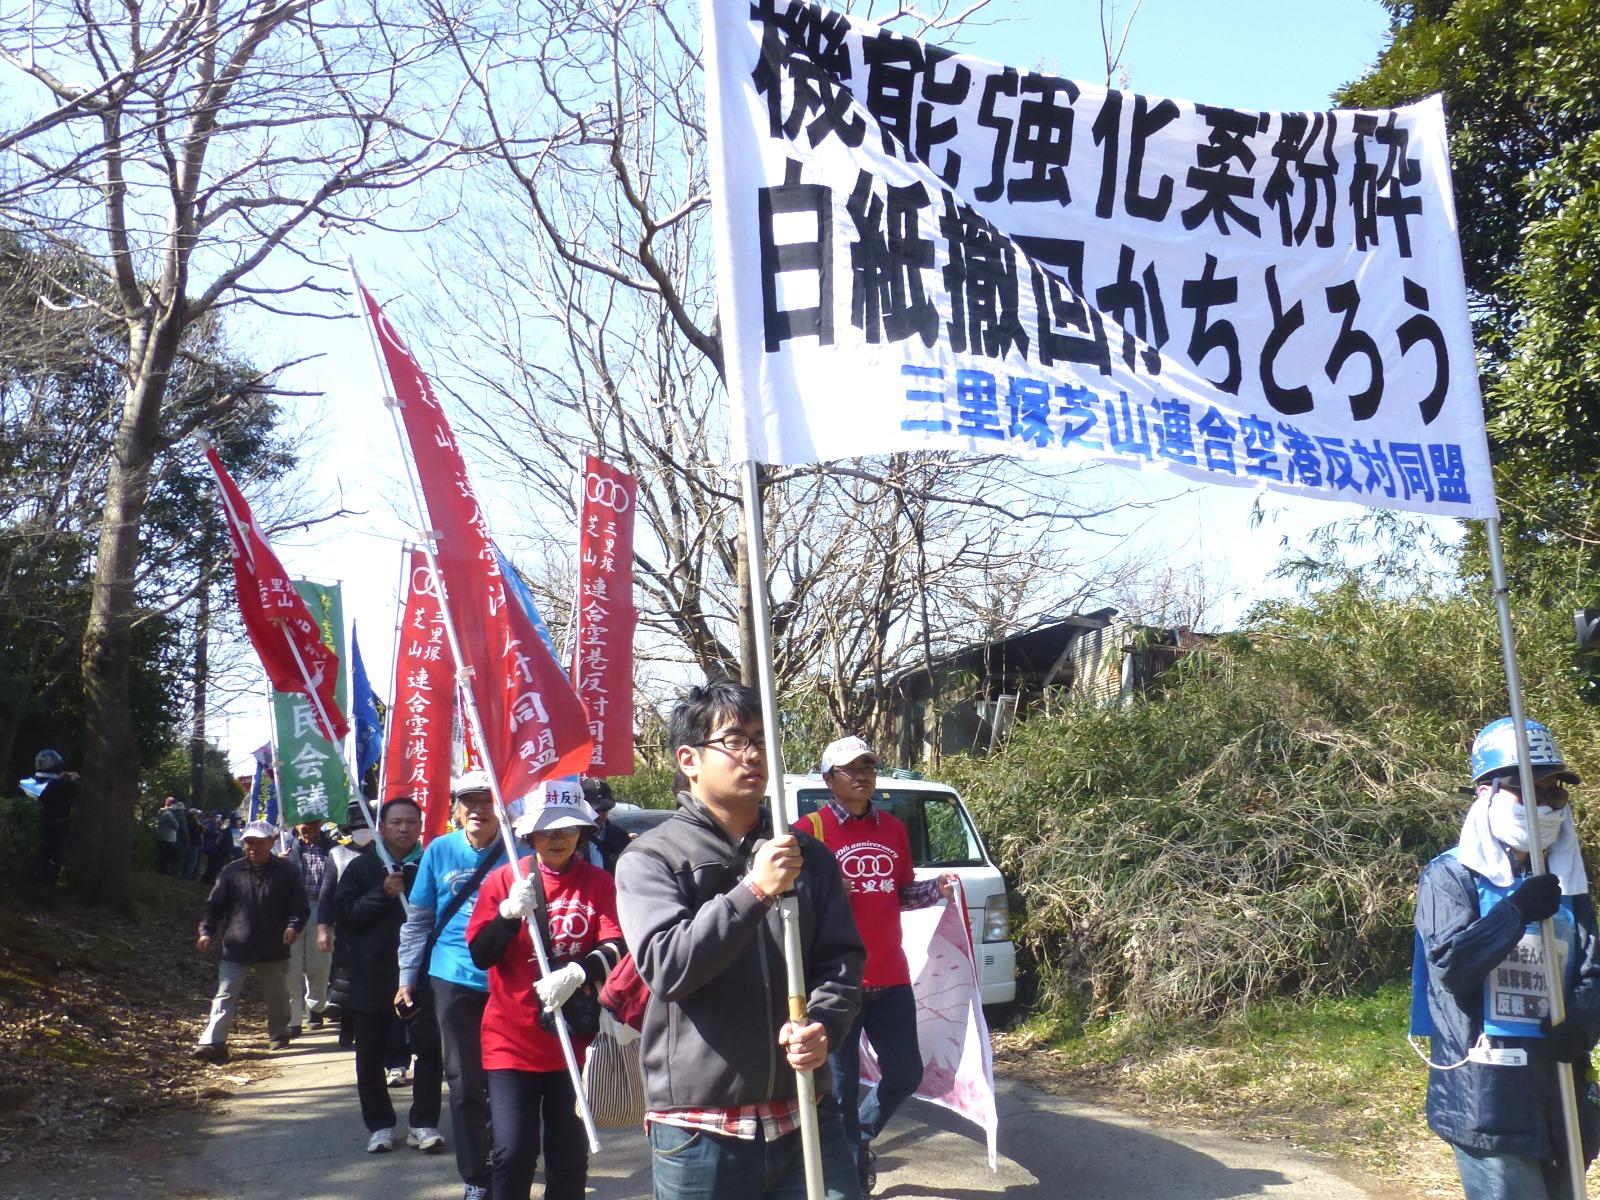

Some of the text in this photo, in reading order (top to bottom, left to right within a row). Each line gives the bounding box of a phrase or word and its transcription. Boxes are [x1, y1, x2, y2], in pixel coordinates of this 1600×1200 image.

[758, 160, 1449, 424] 白紙撤回かちとろう
[901, 364, 1470, 504] 三里塚芝山連合空港反対同盟
[583, 515, 599, 567] 芝山
[600, 521, 617, 573] 三里塚
[408, 607, 426, 658] 芝山
[423, 611, 445, 662] 三里塚
[290, 692, 330, 818] 民会議
